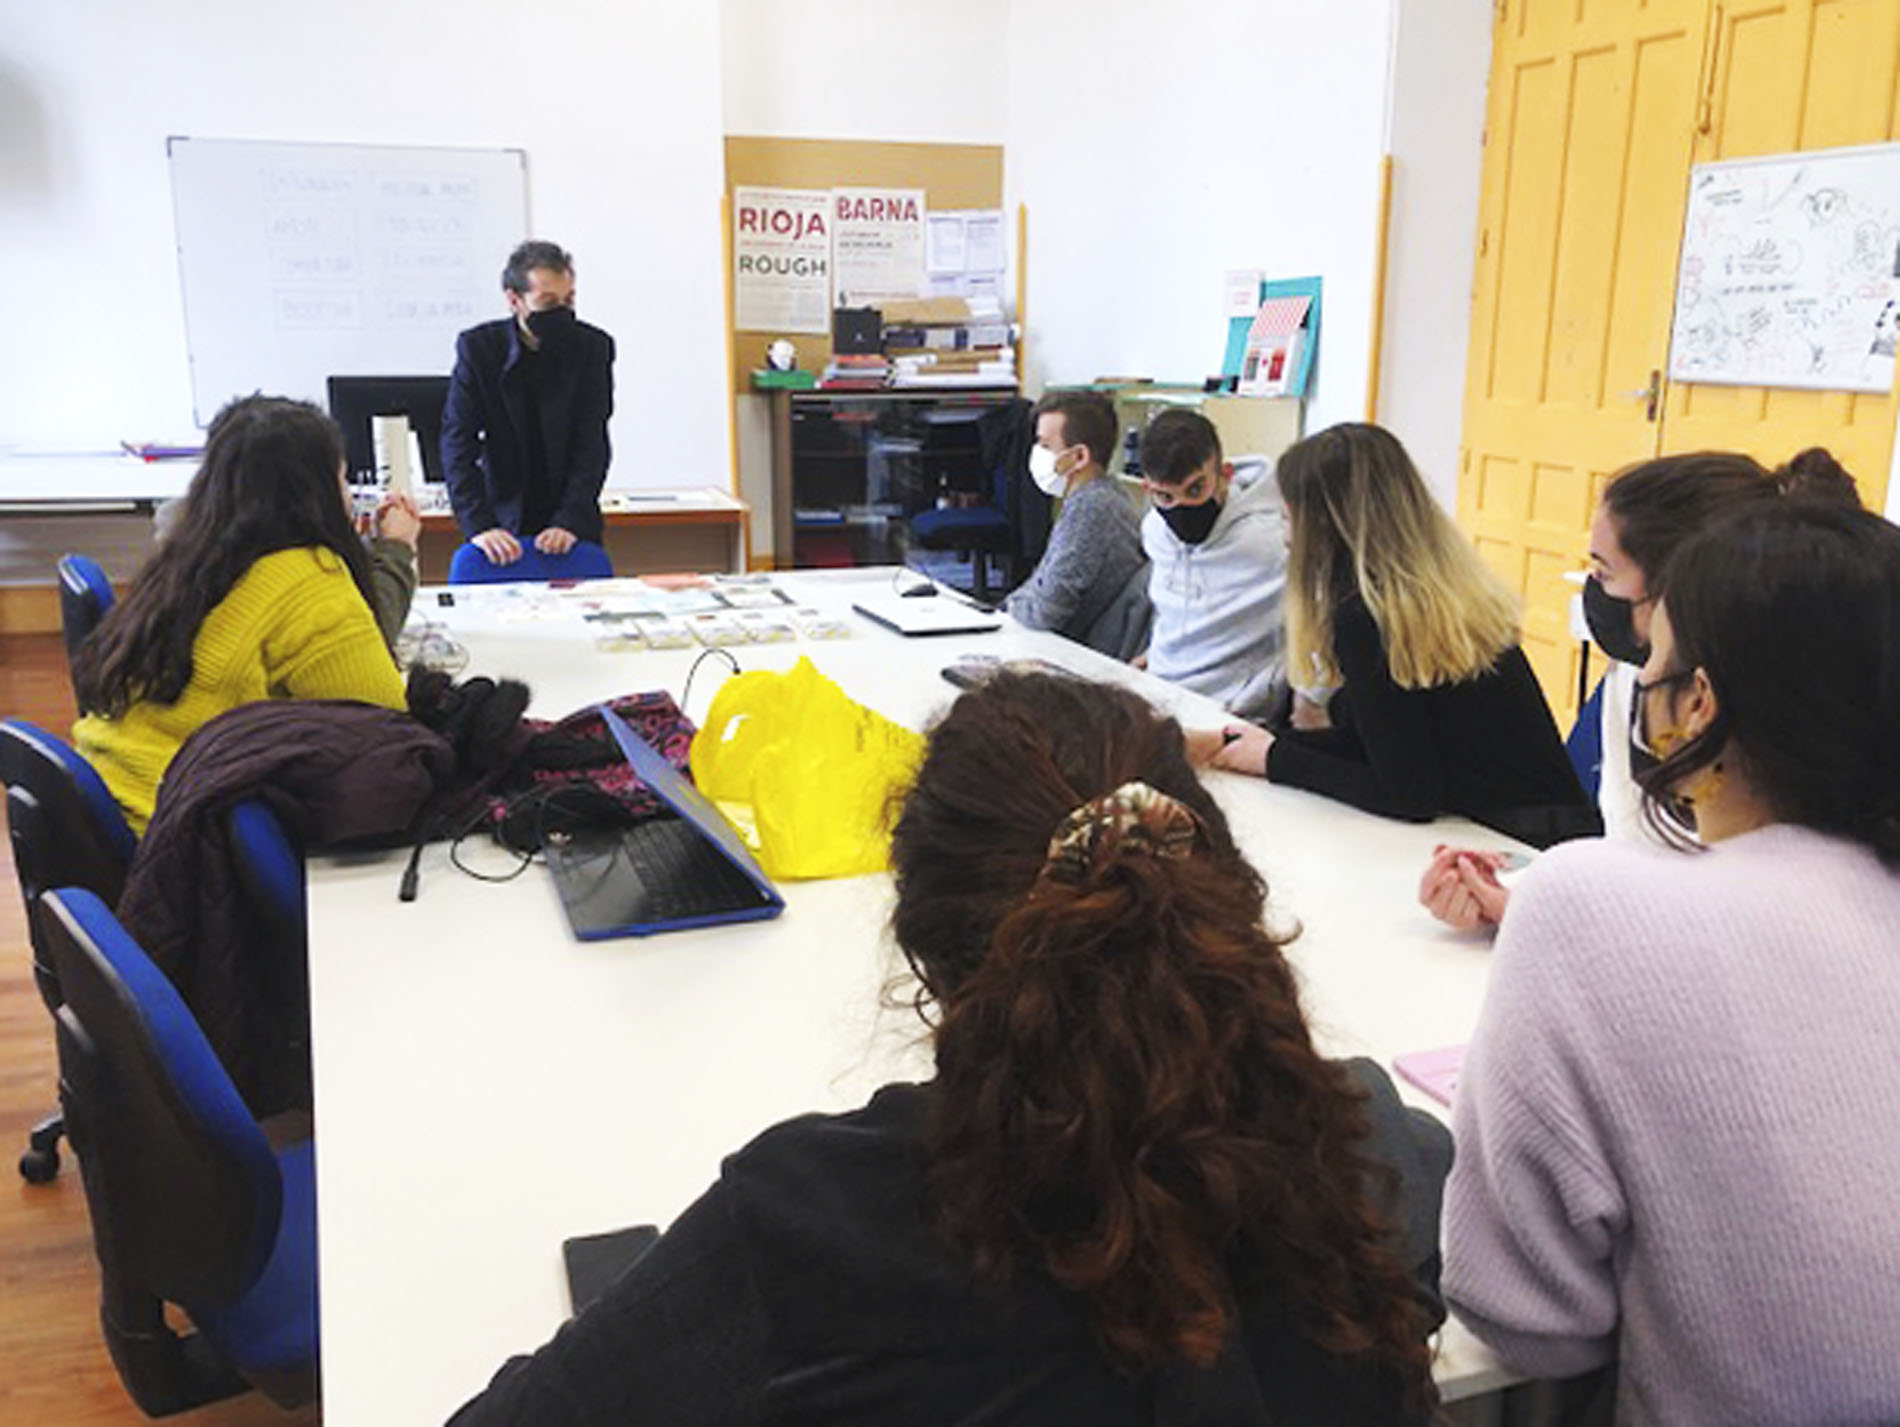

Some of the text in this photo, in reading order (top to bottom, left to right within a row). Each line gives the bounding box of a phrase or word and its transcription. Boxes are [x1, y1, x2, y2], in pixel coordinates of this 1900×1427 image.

[837, 197, 919, 222] BARNA
[739, 208, 826, 240] RIOJA
[739, 255, 826, 277] ROUGH
